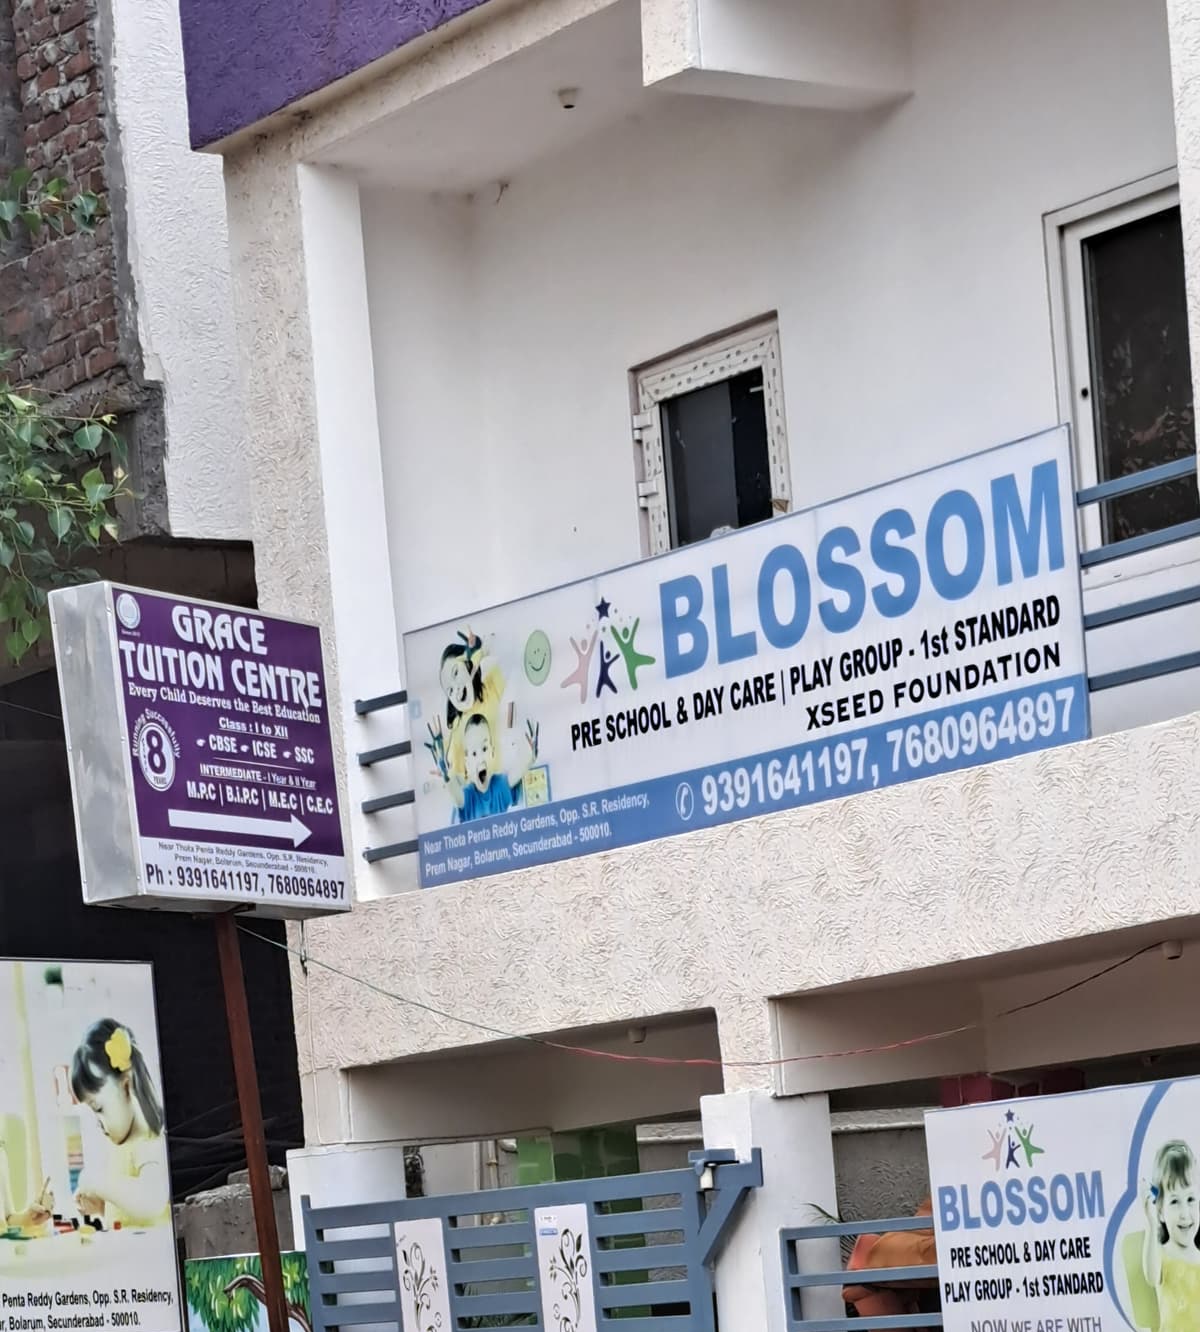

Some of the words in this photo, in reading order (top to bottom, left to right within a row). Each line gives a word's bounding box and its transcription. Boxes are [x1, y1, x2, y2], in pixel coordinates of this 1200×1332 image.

[659, 459, 1066, 680] BLOSSOM
[172, 605, 267, 654] GRACE
[119, 639, 224, 691] TUITION
[231, 659, 322, 709] CENTRE
[571, 718, 602, 752] PRE
[606, 702, 671, 742] SCHOOL
[676, 696, 689, 725] &
[693, 686, 724, 720] DAY
[729, 672, 776, 711] CARE
[790, 657, 833, 695] PLAY
[839, 633, 903, 683] GROUP
[919, 628, 949, 662] 1st
[954, 594, 1061, 652] STANDARD
[805, 689, 884, 731] XSEED
[894, 641, 1061, 709] FOUNDATION
[128, 682, 157, 701] Every
[160, 687, 187, 703] Child
[189, 691, 232, 710] Deserves
[234, 697, 250, 712] the
[252, 701, 273, 716] Best
[275, 704, 321, 724] Education
[219, 717, 247, 730] Class
[261, 724, 272, 735] to
[274, 726, 288, 737] XII
[146, 730, 166, 774] 8
[209, 734, 238, 753] CBSE
[252, 740, 277, 759] ICSE
[294, 746, 315, 764] SSC
[702, 736, 878, 815] 9391641197,
[886, 686, 1076, 773] 7680964897
[200, 763, 262, 781] INTERMEDIATE
[272, 773, 286, 785] Year
[301, 776, 316, 788] Year
[186, 780, 217, 801] M.P.C
[268, 790, 298, 810] M.E.C
[306, 794, 334, 815] C.E.C
[424, 840, 442, 856] Near
[443, 834, 466, 851] Thota
[467, 828, 492, 844] Penta
[492, 822, 519, 841] Reddy
[520, 815, 559, 832] Gardens,
[559, 808, 581, 824] Opp.
[582, 802, 600, 818] S.R.
[602, 792, 650, 815] Residency,
[425, 861, 446, 877] Prem
[447, 856, 473, 872] Nagar,
[474, 847, 511, 866] Bolarum,
[512, 831, 573, 857] Secunderabad
[579, 822, 612, 842] 500010.
[145, 863, 164, 886] Ph
[177, 866, 265, 896] 9391641197,
[268, 874, 345, 900] 7680964897
[937, 1169, 1106, 1232] BLOSSOM
[950, 1244, 971, 1268] PRE
[974, 1241, 1020, 1267] SCHOOL
[1023, 1240, 1032, 1262] &
[1035, 1239, 1057, 1263] DAY
[1059, 1236, 1091, 1261] CARE
[2, 1293, 25, 1308] Penta
[27, 1291, 53, 1310] Reddy
[54, 1291, 91, 1307] Gardens,
[92, 1290, 112, 1308] Opp.
[113, 1289, 130, 1304] S.R.
[131, 1289, 174, 1306] Residency,
[945, 1279, 972, 1304] PLAY
[974, 1276, 1014, 1302] GROUP
[1022, 1276, 1040, 1299] 1st
[1042, 1271, 1104, 1296] STANDARD
[9, 1315, 46, 1332] Bolarum,
[47, 1312, 104, 1329] Secunderabad
[111, 1311, 141, 1327] 500010.
